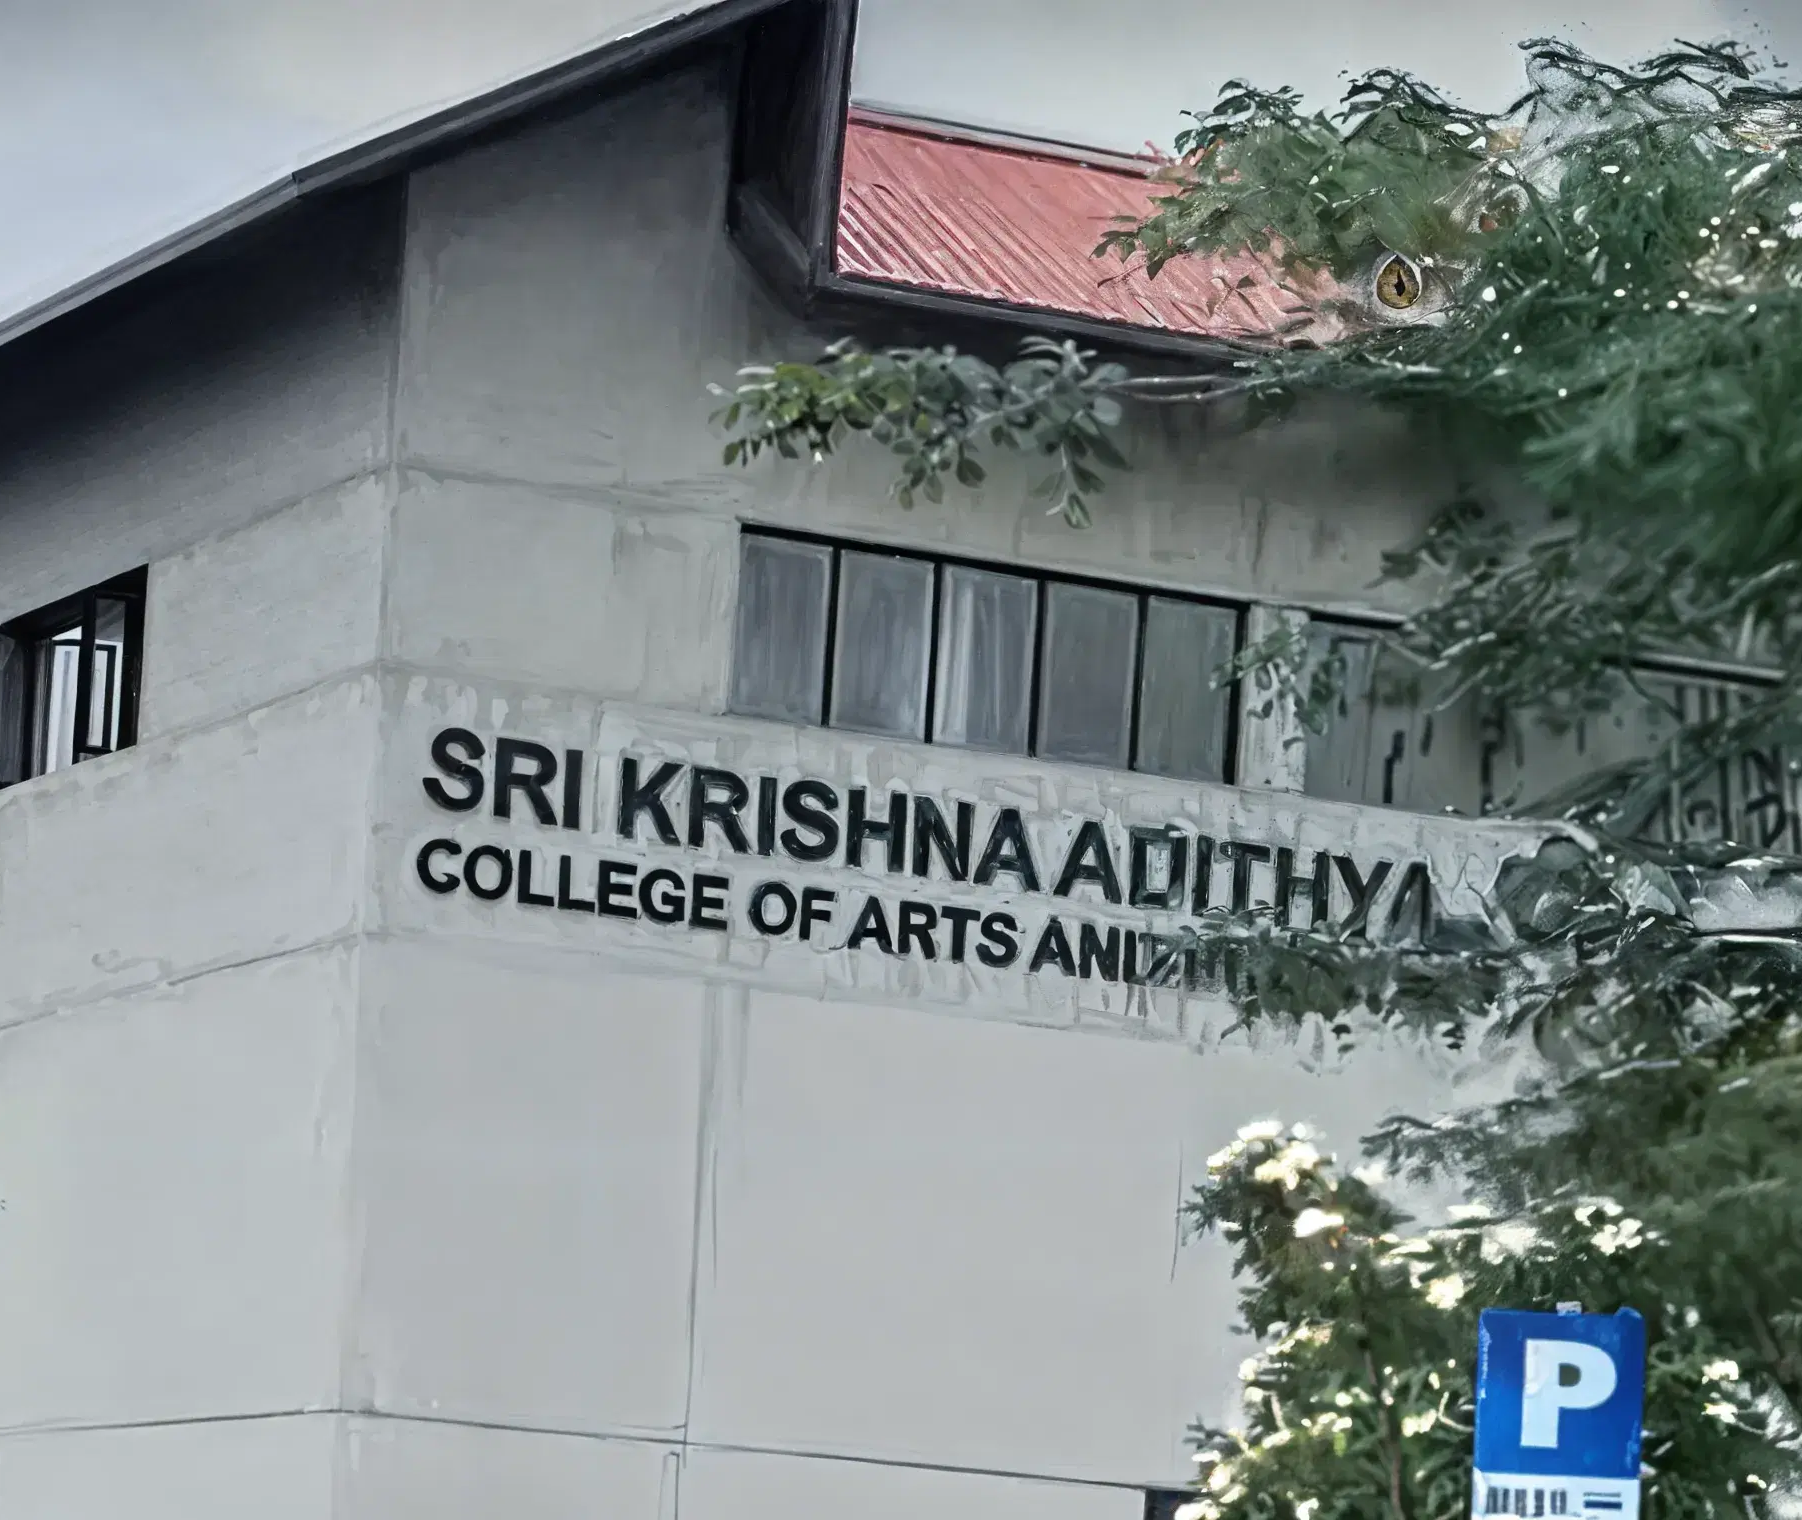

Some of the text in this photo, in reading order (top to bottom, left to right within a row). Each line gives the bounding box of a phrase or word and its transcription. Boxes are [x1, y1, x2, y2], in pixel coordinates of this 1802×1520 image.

[422, 727, 1437, 947] SRI KRISHNA ADITHYA
[416, 838, 730, 931] COLLEGE
[748, 881, 837, 941] OF
[847, 895, 1019, 969] ARTS
[1519, 1338, 1618, 1449] P
